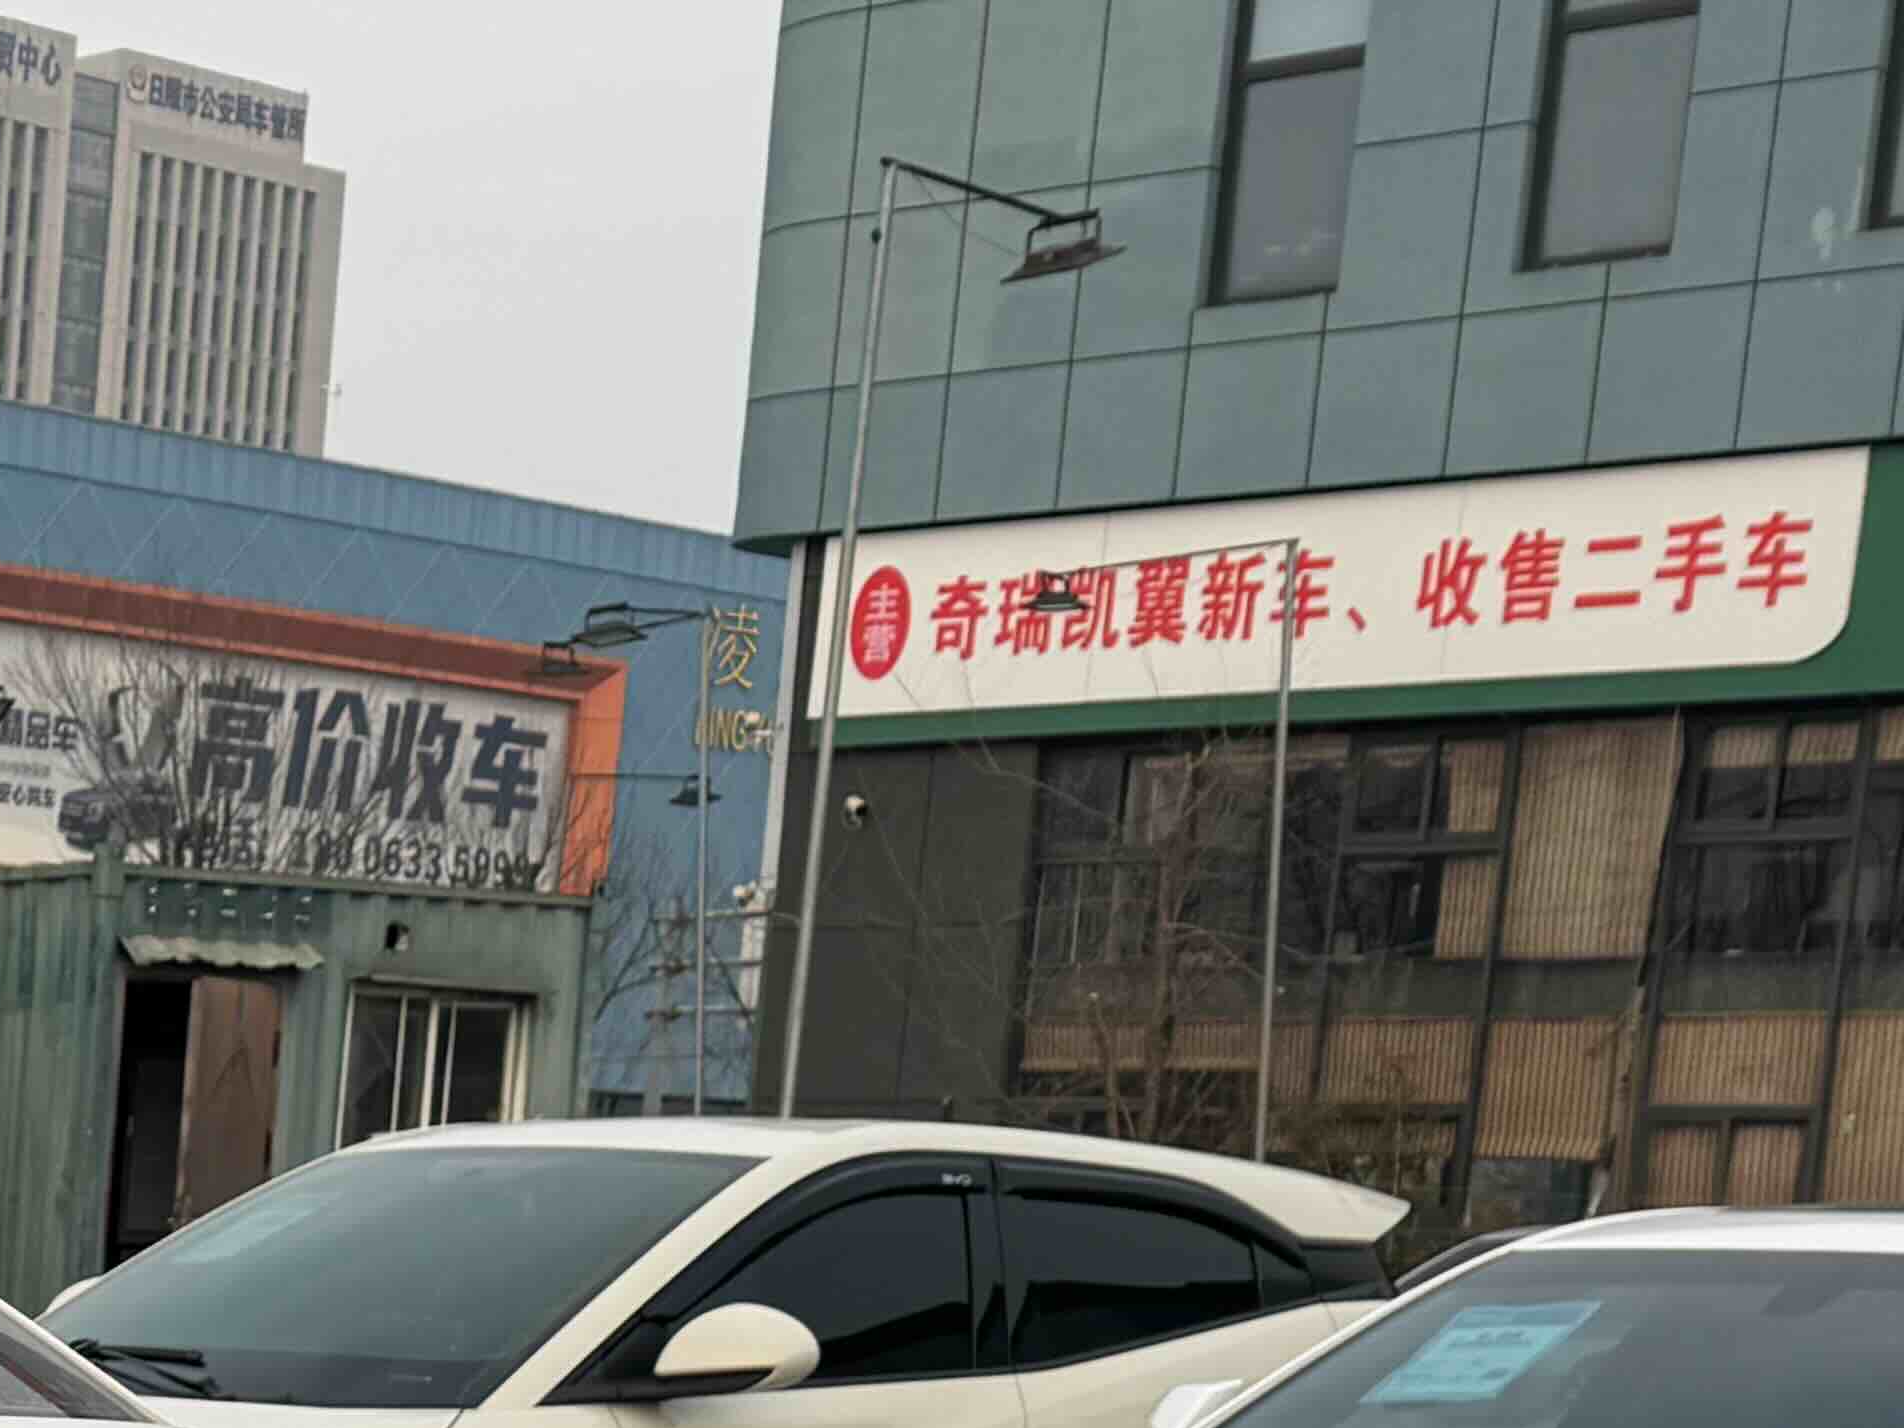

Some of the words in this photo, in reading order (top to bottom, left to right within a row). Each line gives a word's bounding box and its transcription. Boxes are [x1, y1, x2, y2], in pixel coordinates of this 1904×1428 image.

[863, 585, 901, 664] 主营
[929, 510, 1814, 661] 奇瑞凯翼新车、收售二手车
[190, 677, 549, 830] 高价收车
